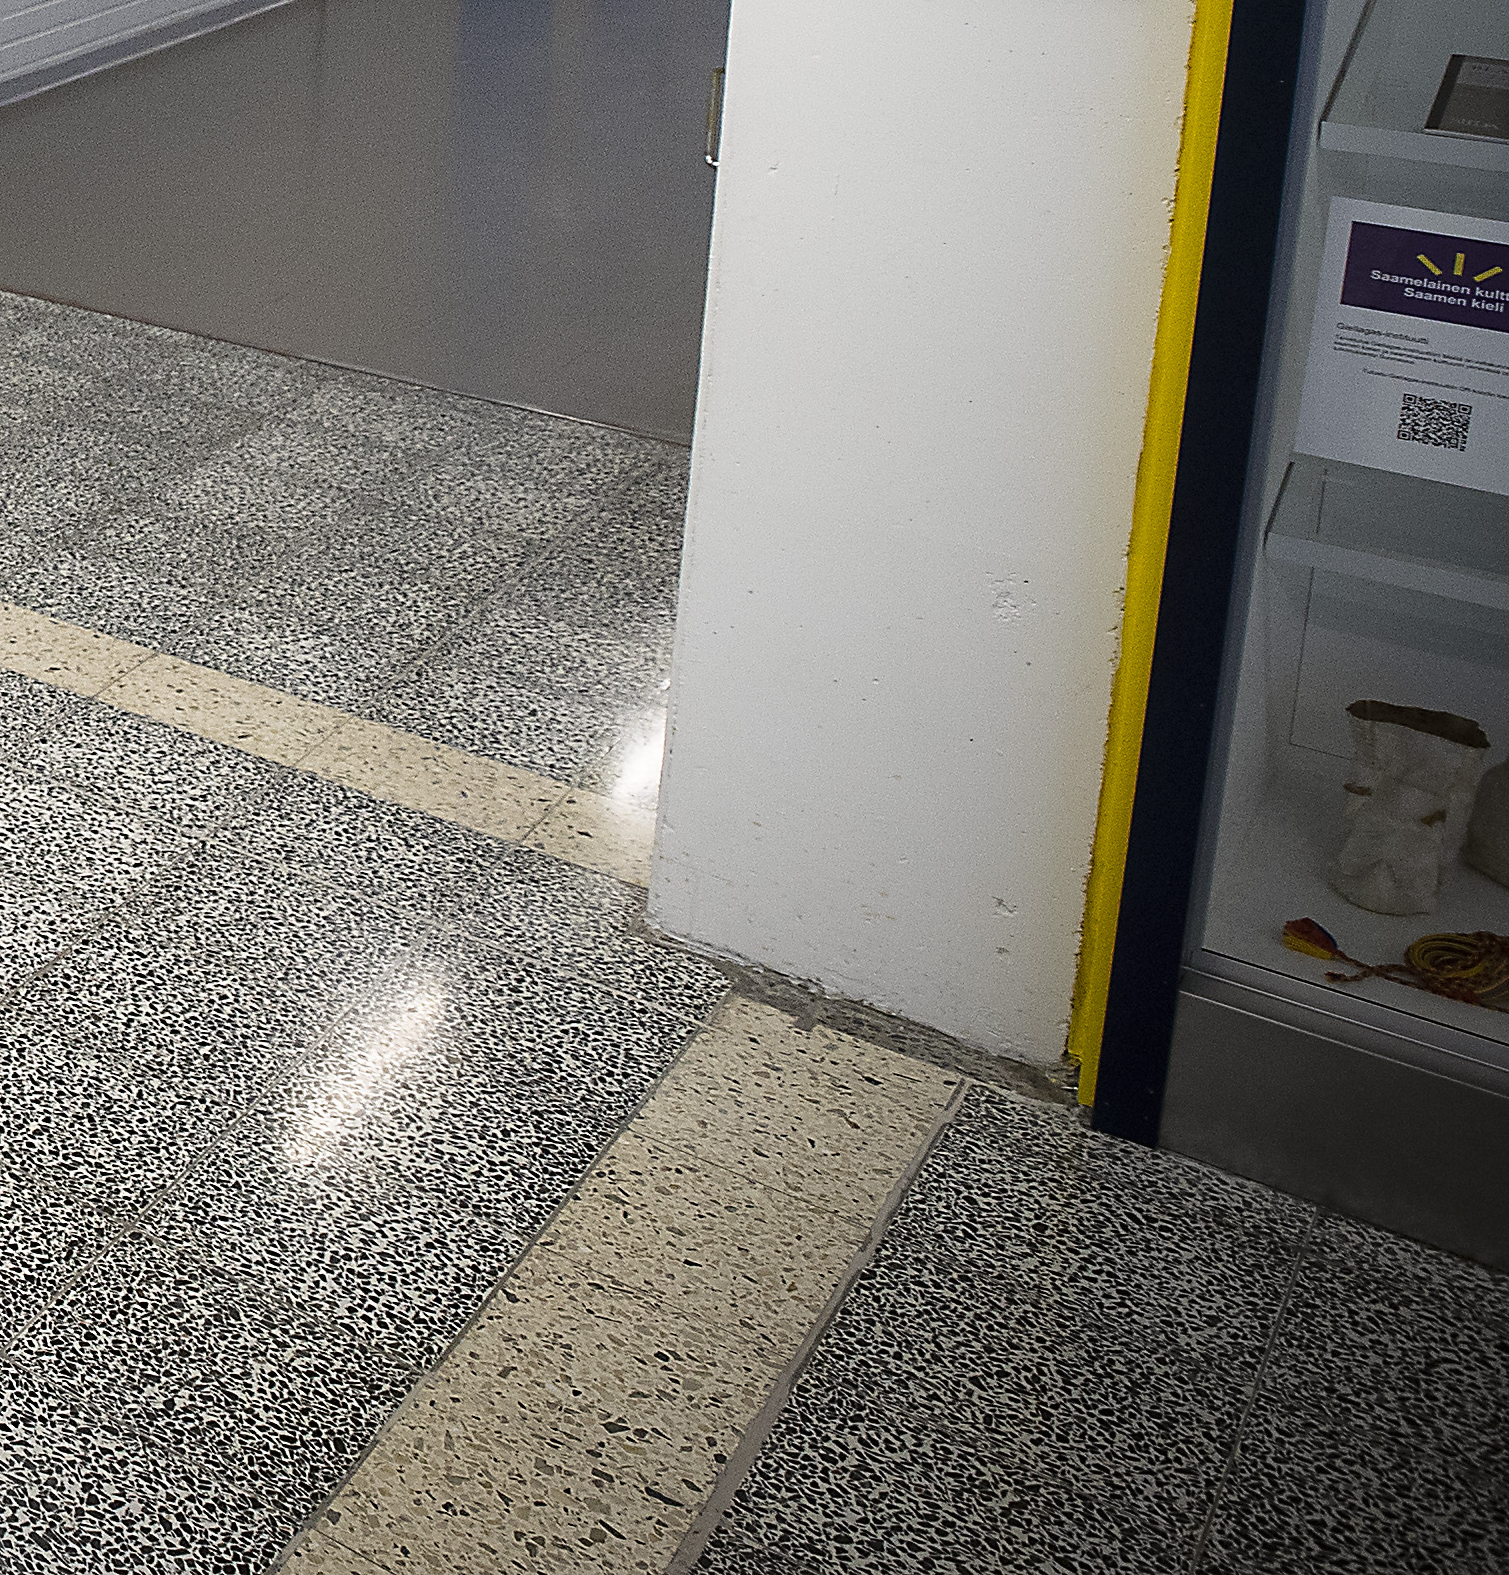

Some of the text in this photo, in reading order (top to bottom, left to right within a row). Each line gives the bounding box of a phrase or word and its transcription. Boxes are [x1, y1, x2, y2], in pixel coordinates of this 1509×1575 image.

[1369, 269, 1471, 295] Saamelainen
[1403, 287, 1505, 313] Saamen kieli
